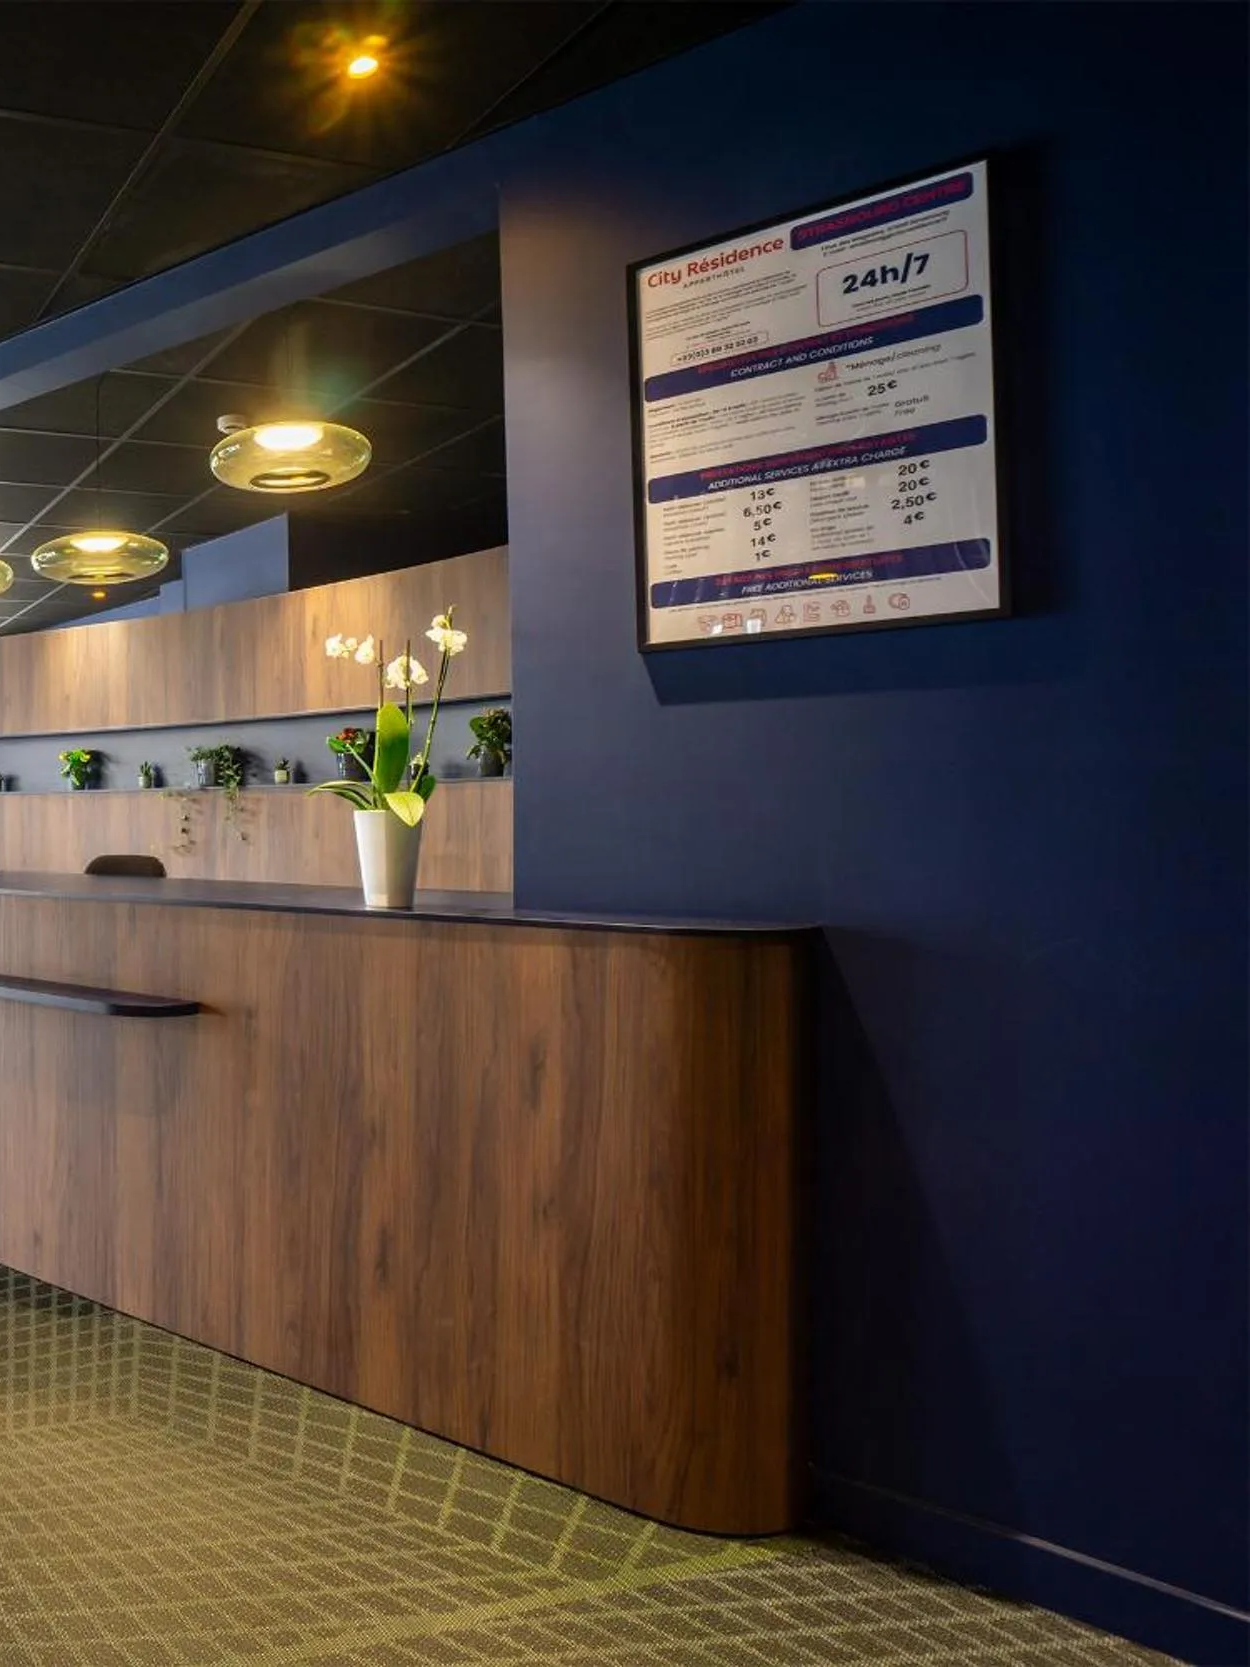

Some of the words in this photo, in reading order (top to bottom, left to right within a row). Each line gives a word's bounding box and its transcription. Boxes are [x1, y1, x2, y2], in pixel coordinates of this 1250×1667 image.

[648, 268, 682, 288] City
[688, 238, 784, 277] Résidence
[842, 253, 930, 294] 24h/7
[730, 357, 784, 378] CONTRACT
[786, 351, 807, 365] AND
[808, 336, 875, 360] CONDITIONS
[708, 473, 762, 490] ADDITIONAL
[764, 464, 809, 481] SERVICES
[861, 446, 906, 463] CHARGE
